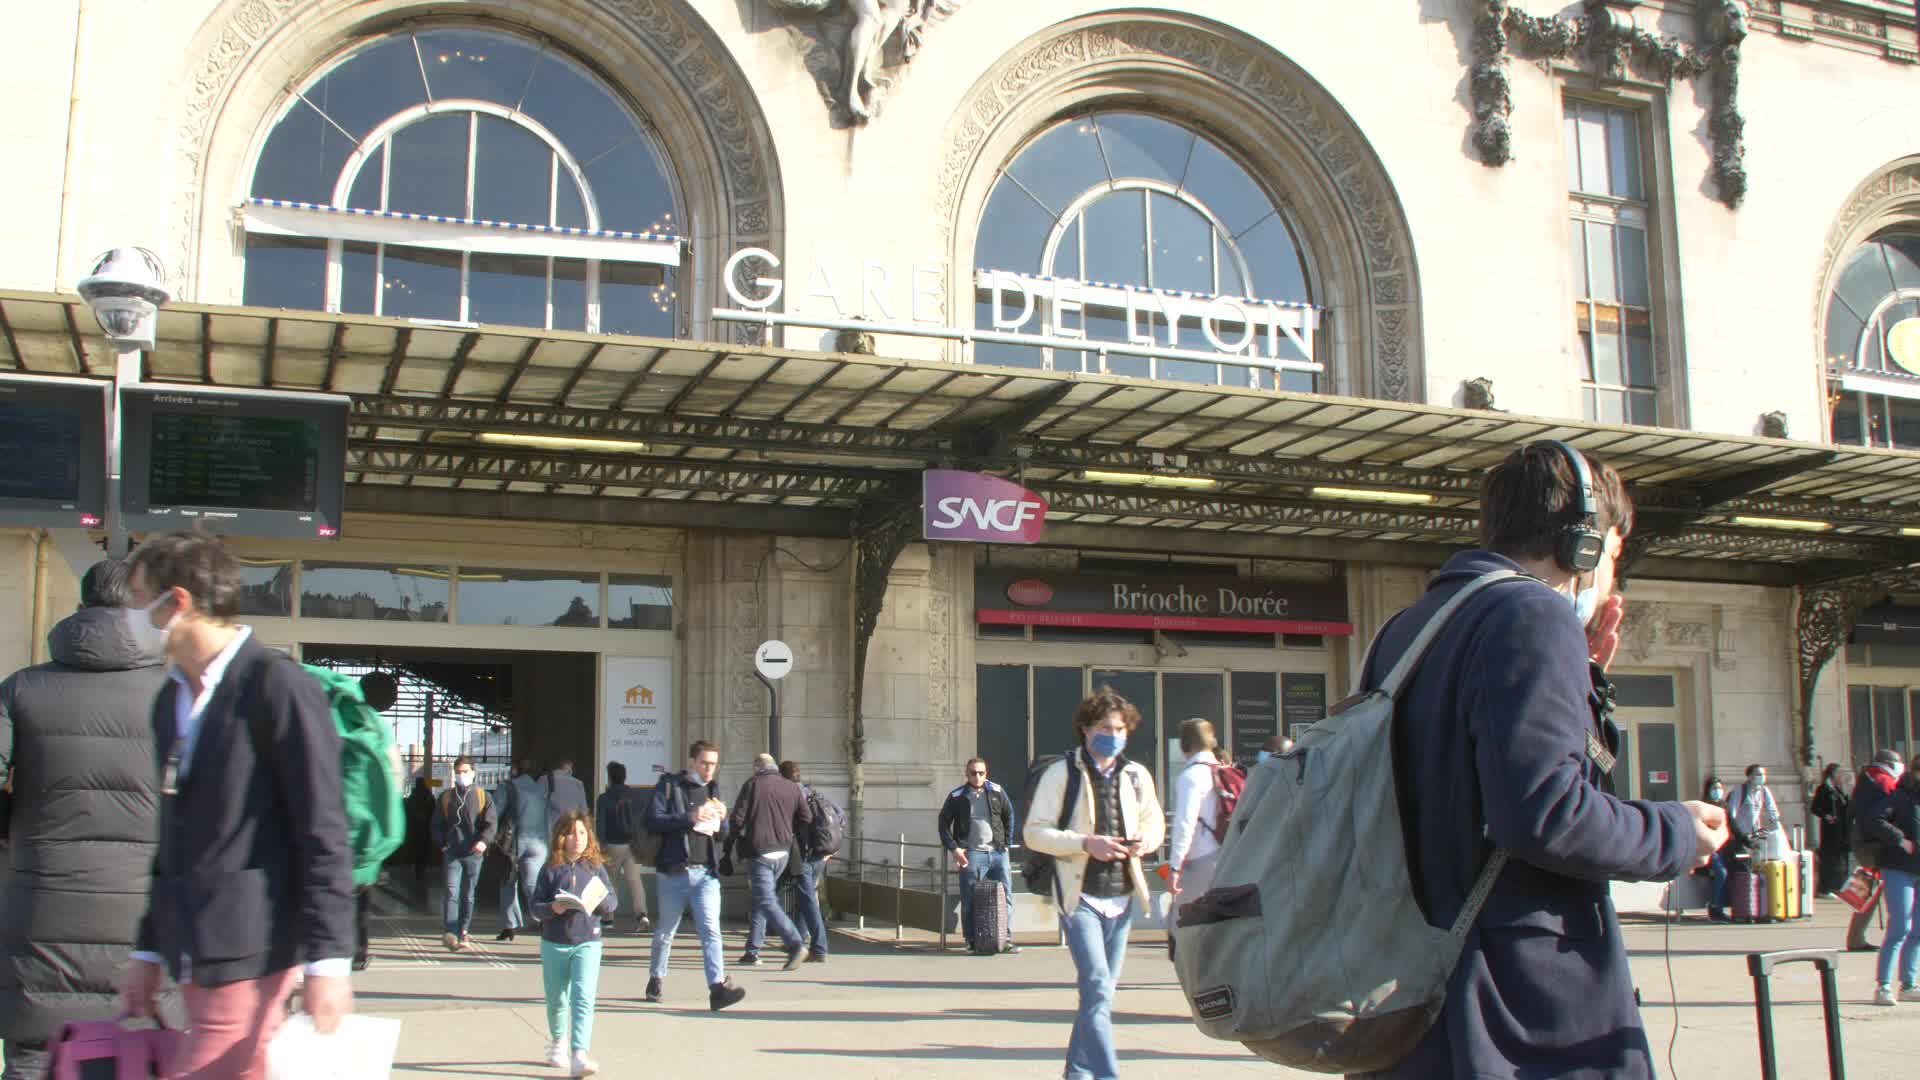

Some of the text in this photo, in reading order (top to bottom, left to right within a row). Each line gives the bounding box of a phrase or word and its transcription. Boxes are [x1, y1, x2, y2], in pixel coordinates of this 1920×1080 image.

[724, 247, 1314, 361] GARE DE LYON
[932, 496, 1041, 531] SNCF
[1112, 583, 1288, 616] Brioche Dorée
[619, 717, 657, 725] WELCOME
